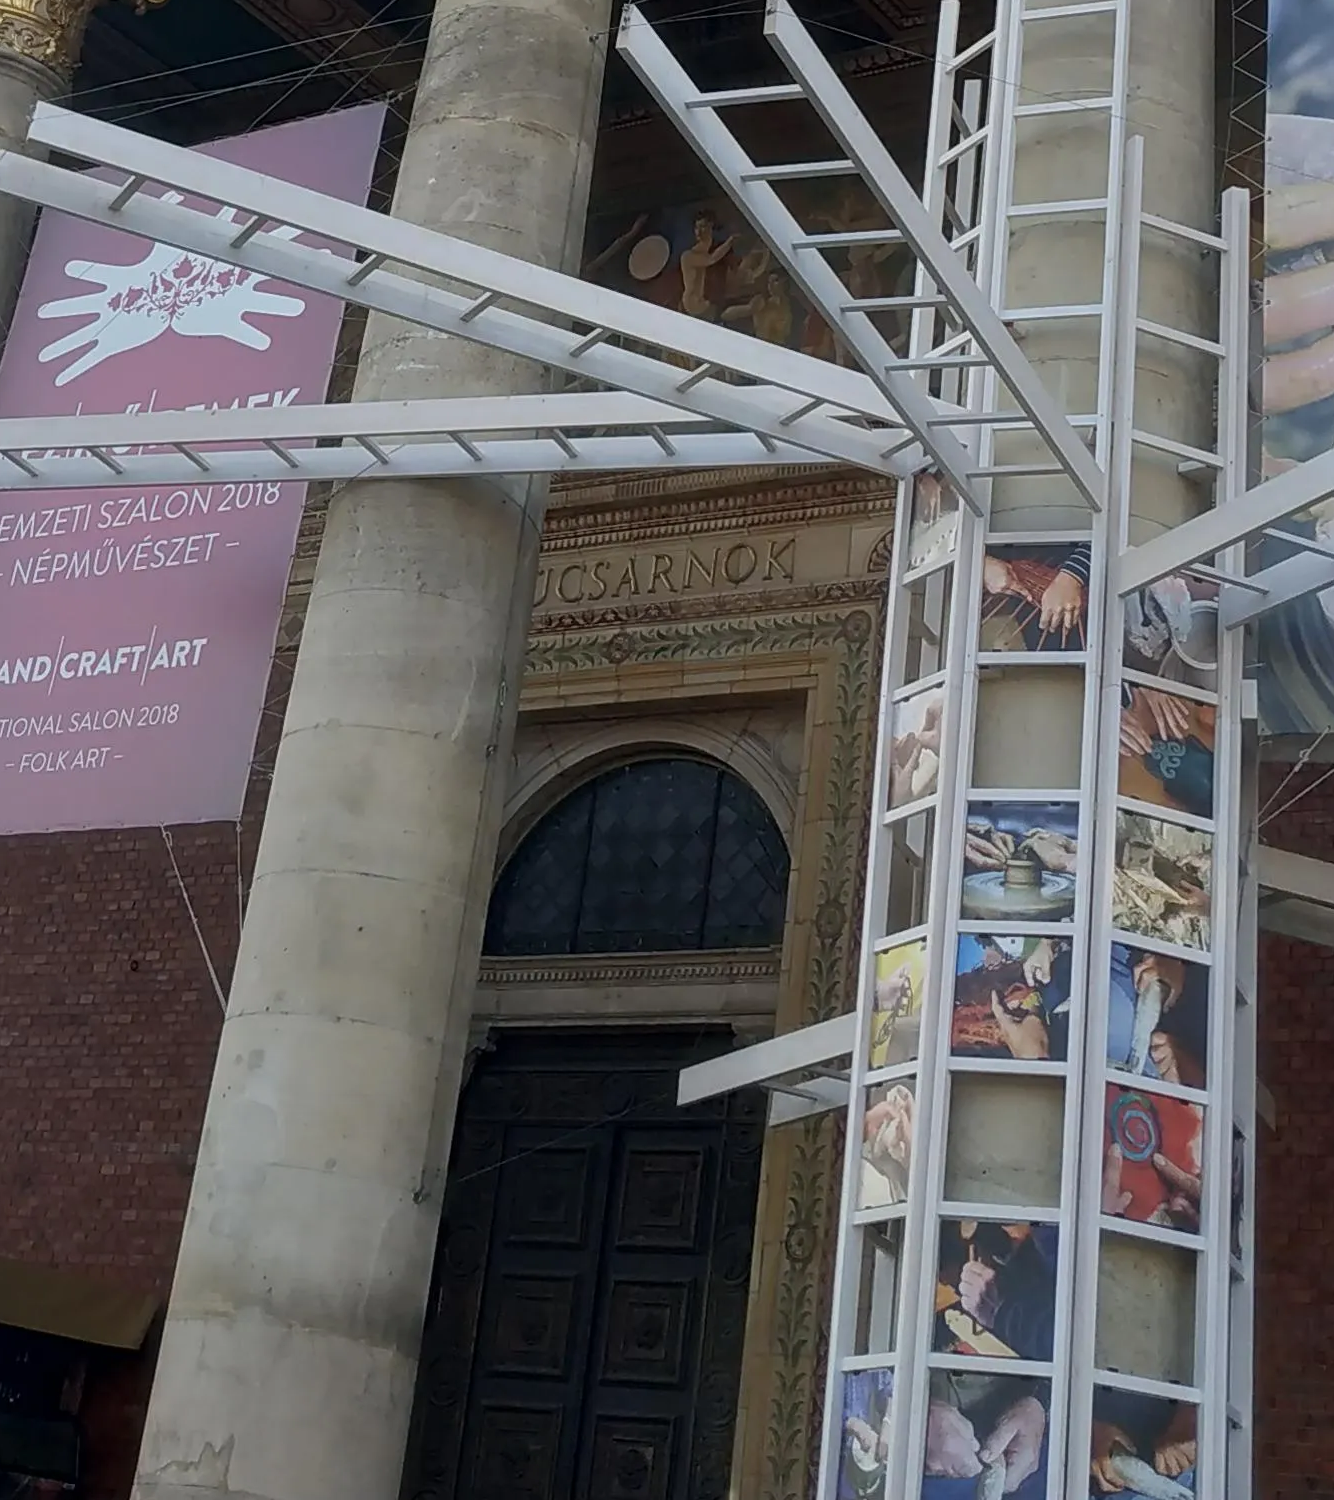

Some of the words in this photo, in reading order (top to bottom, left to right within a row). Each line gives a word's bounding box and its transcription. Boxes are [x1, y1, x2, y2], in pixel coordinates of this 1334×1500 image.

[97, 486, 213, 530] SZALON
[216, 482, 282, 513] 2018
[10, 533, 221, 587] NÉPMŰVÉSZET
[68, 707, 135, 732] SALON
[137, 703, 180, 727] 2018
[18, 750, 69, 773] FOLK
[70, 747, 110, 770] ART
